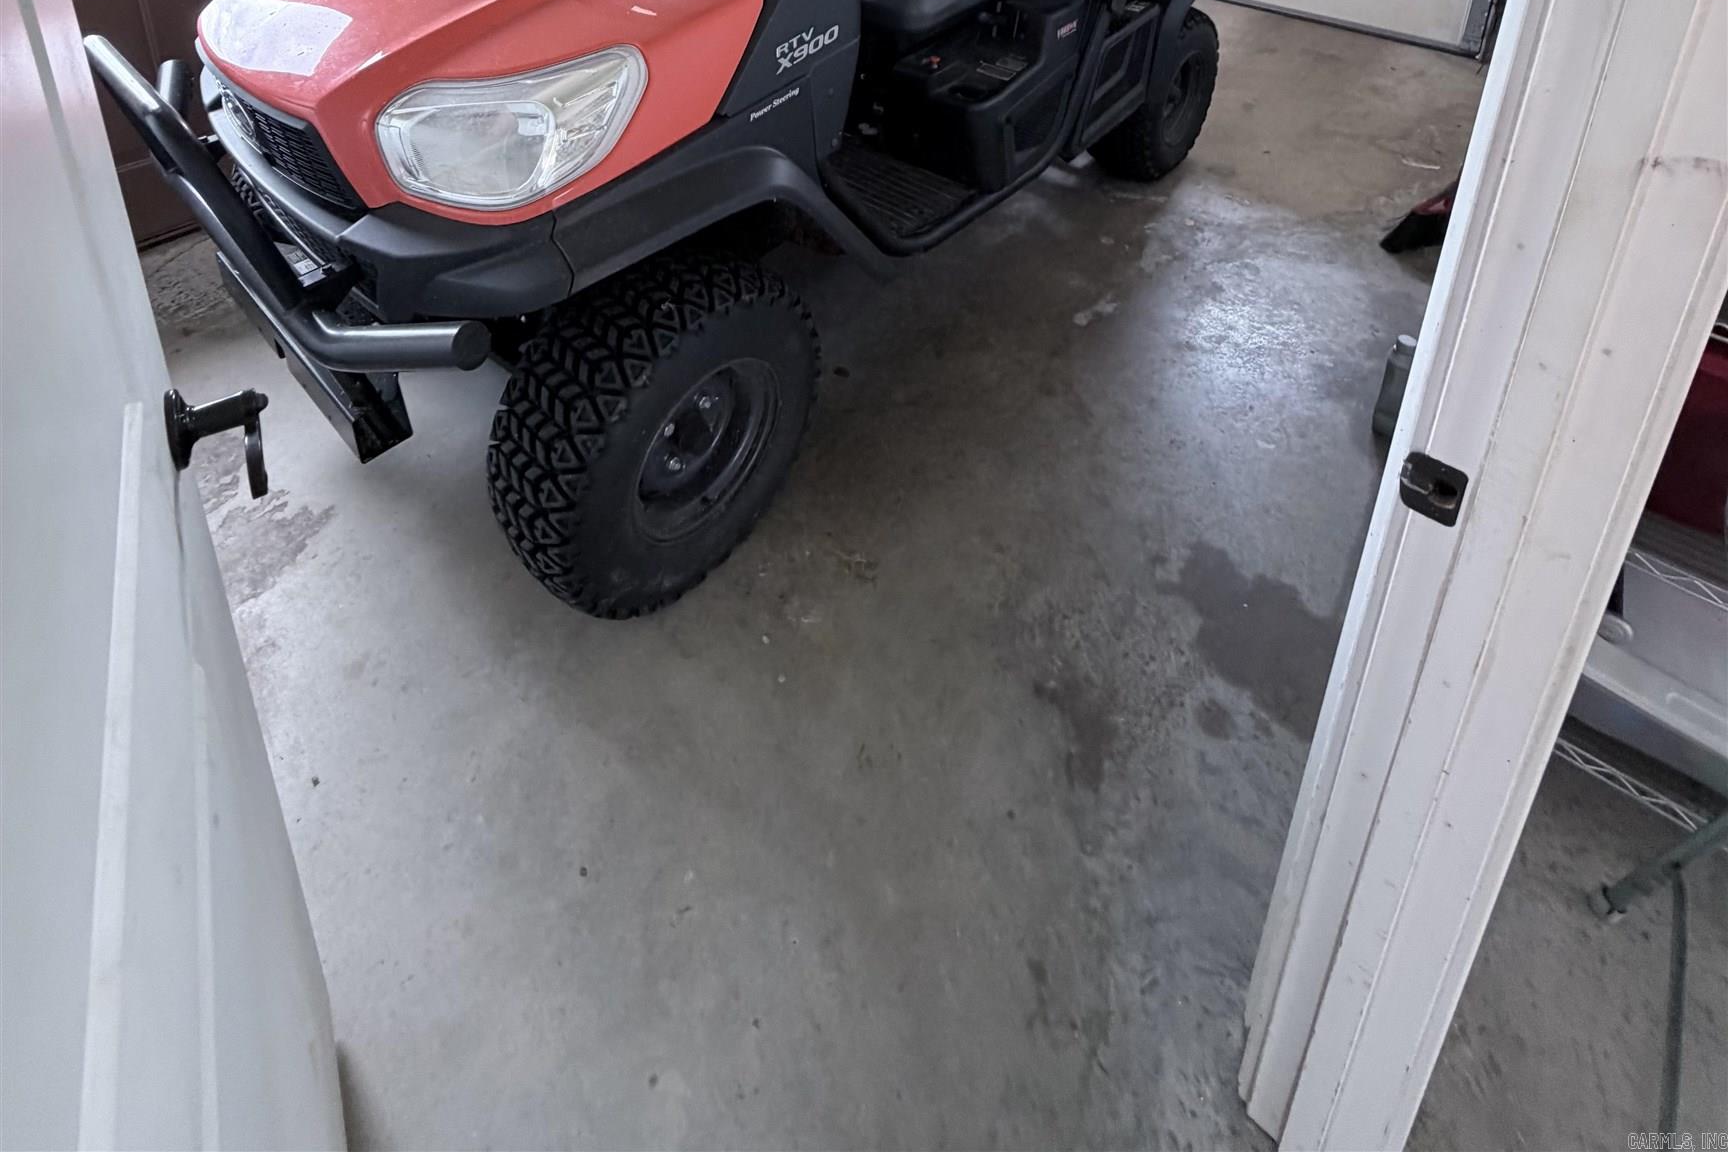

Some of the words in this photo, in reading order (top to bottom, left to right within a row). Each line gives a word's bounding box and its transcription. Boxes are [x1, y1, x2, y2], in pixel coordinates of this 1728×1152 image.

[775, 26, 815, 59] RTV
[775, 24, 840, 76] X900
[750, 103, 773, 123] Power
[772, 87, 800, 109] Steering
